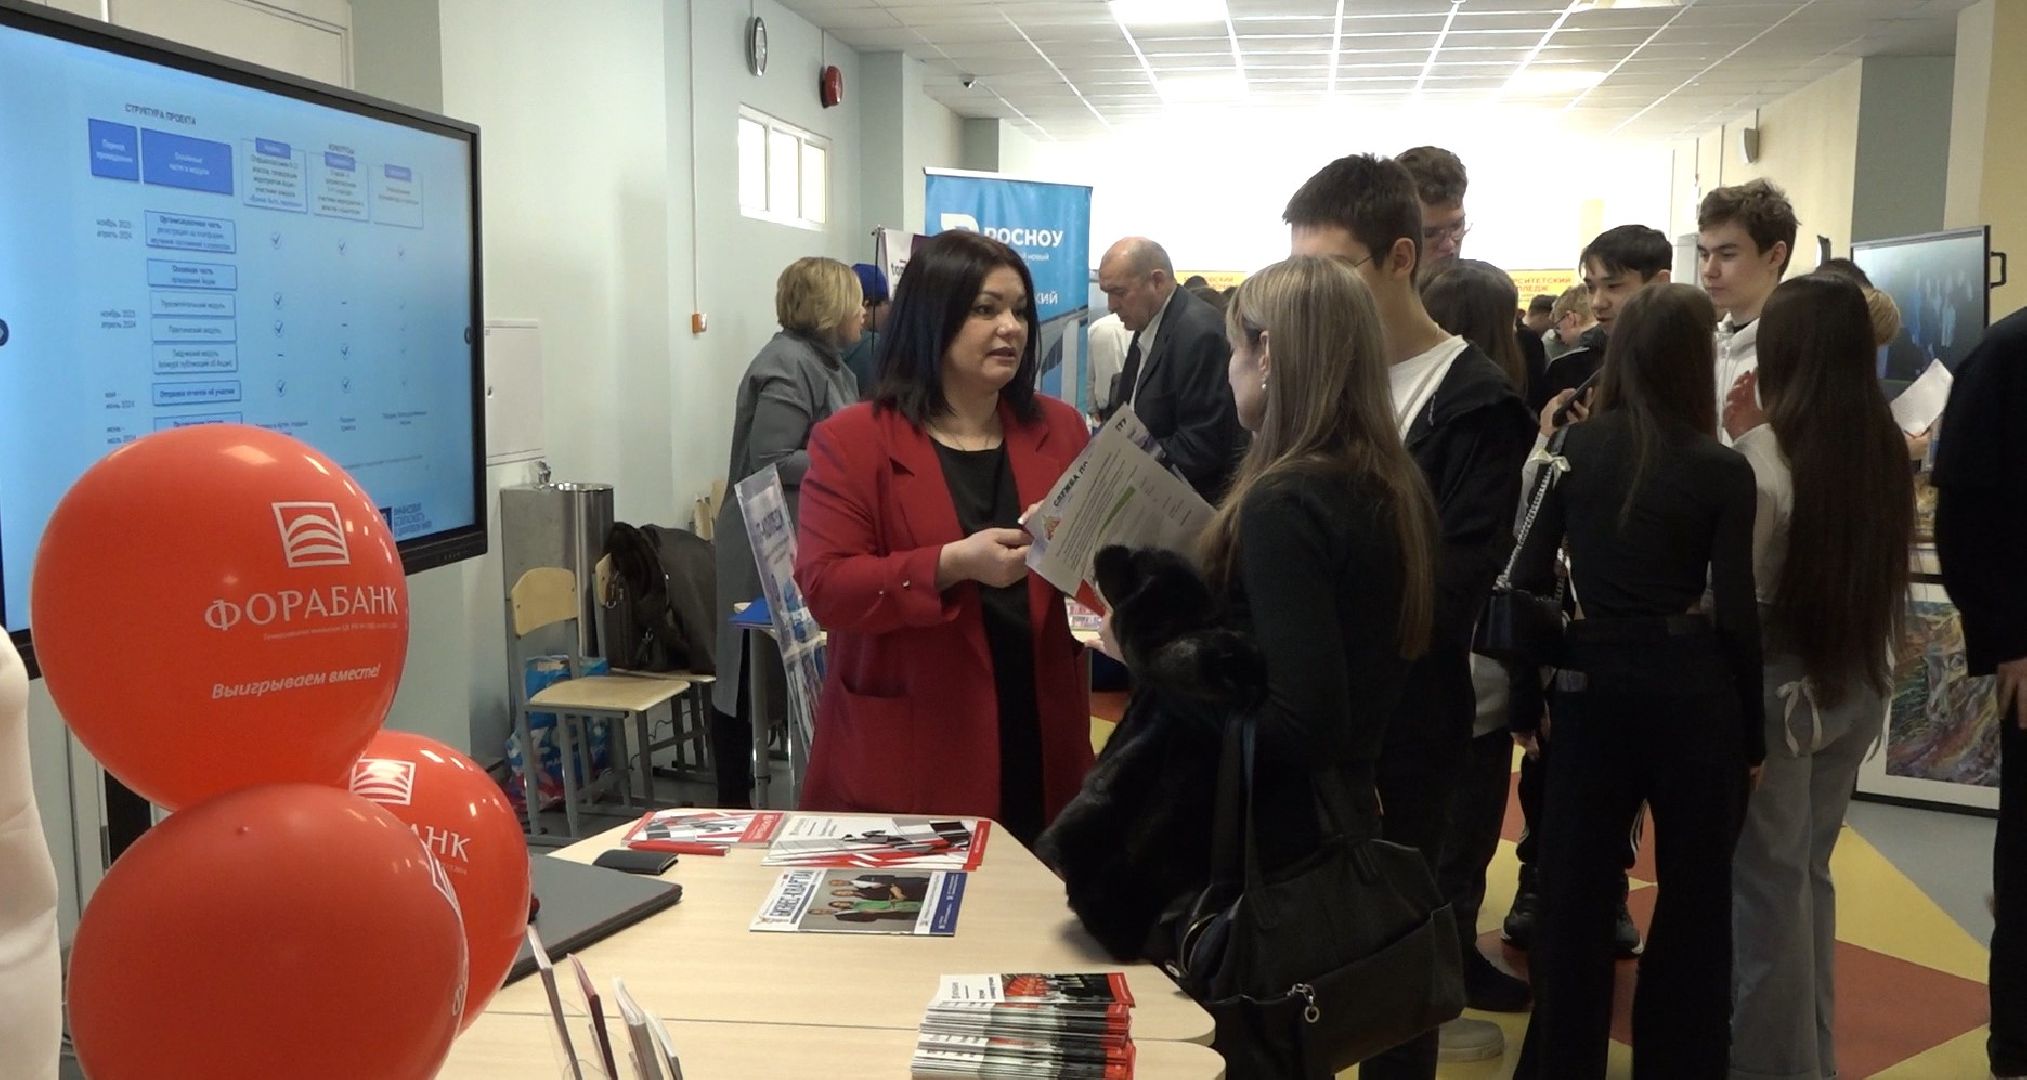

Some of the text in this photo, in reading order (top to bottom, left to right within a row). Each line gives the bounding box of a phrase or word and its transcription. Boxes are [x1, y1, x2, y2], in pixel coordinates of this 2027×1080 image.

[984, 227, 1063, 247] РОСНОУ
[204, 586, 399, 631] ФОРАБАНК
[211, 664, 382, 699] Выигрываем вместе!
[411, 823, 472, 863] НК
